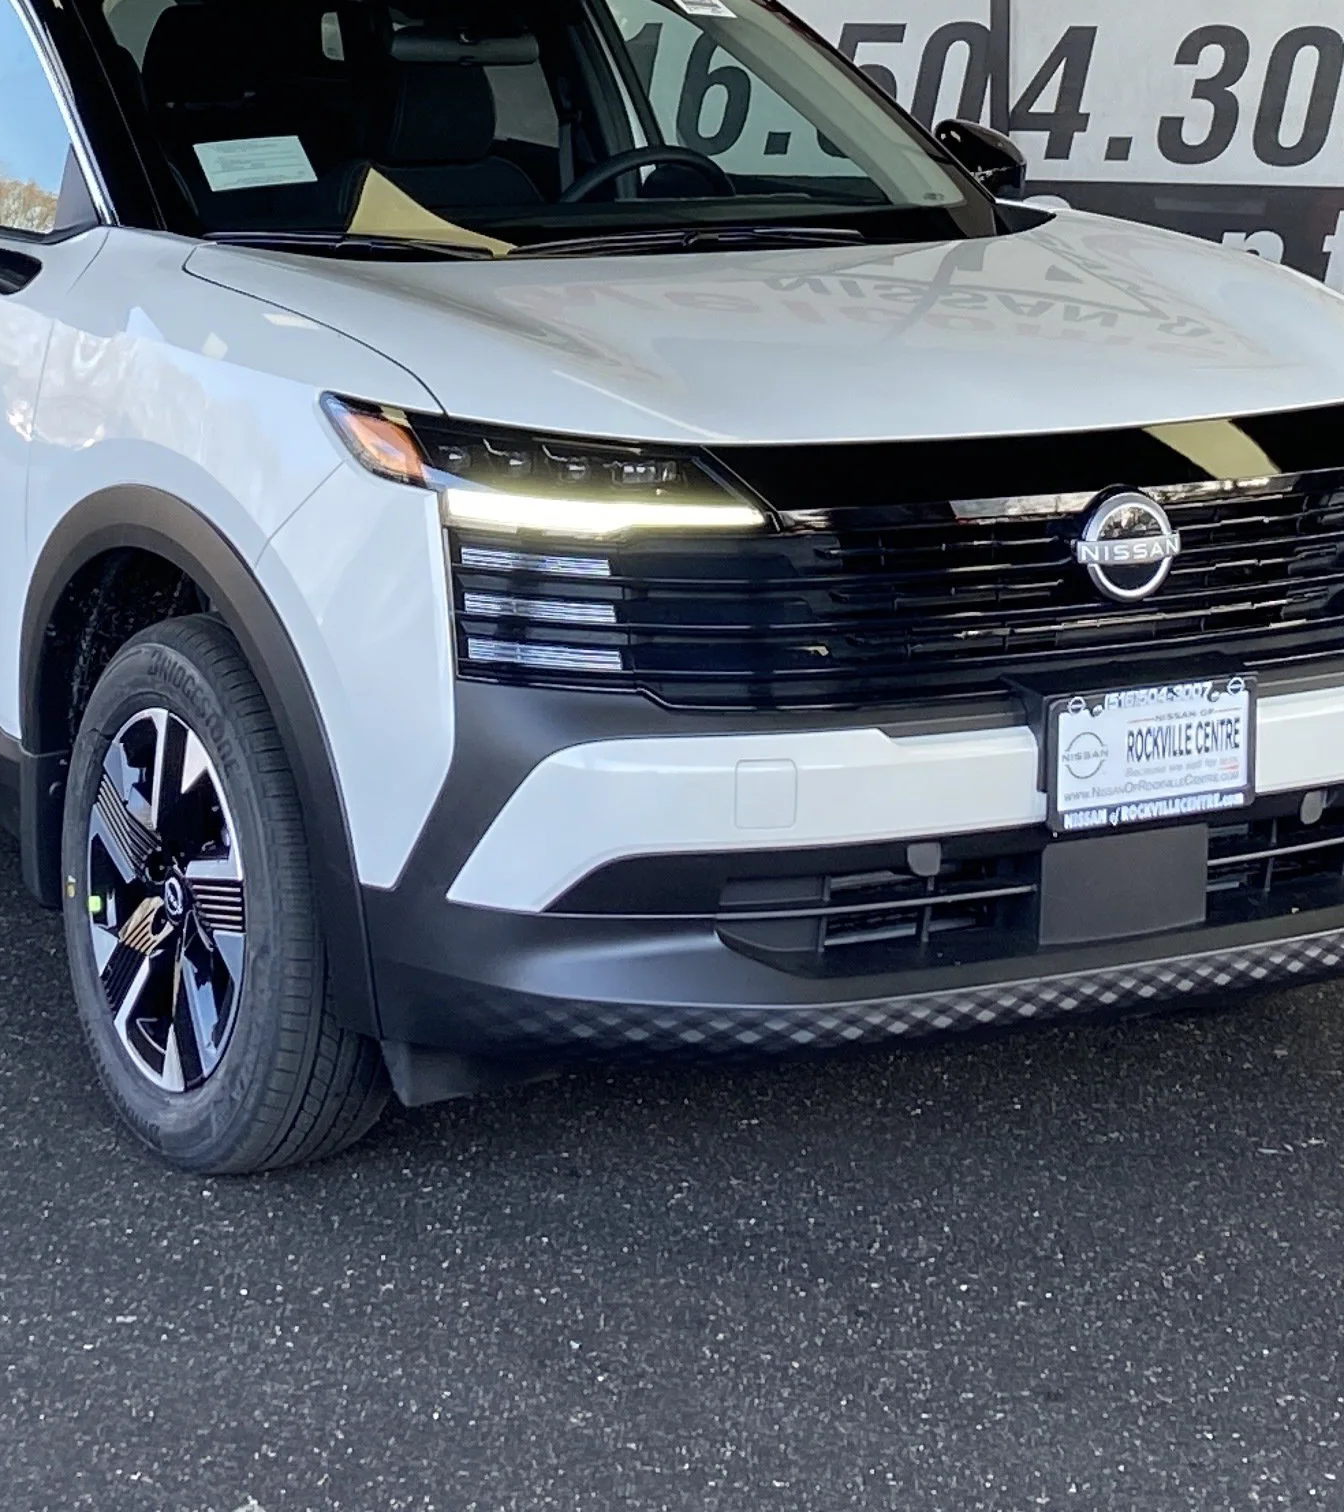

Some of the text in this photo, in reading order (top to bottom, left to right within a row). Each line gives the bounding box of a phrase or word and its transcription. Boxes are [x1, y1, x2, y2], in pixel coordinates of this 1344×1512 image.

[1080, 536, 1179, 561] NISSAN
[1154, 710, 1197, 723] NISSAN
[1126, 716, 1241, 763] ROCKVILLE CENTRE
[1062, 749, 1109, 763] NISSAN
[1064, 808, 1107, 830] NISSAN
